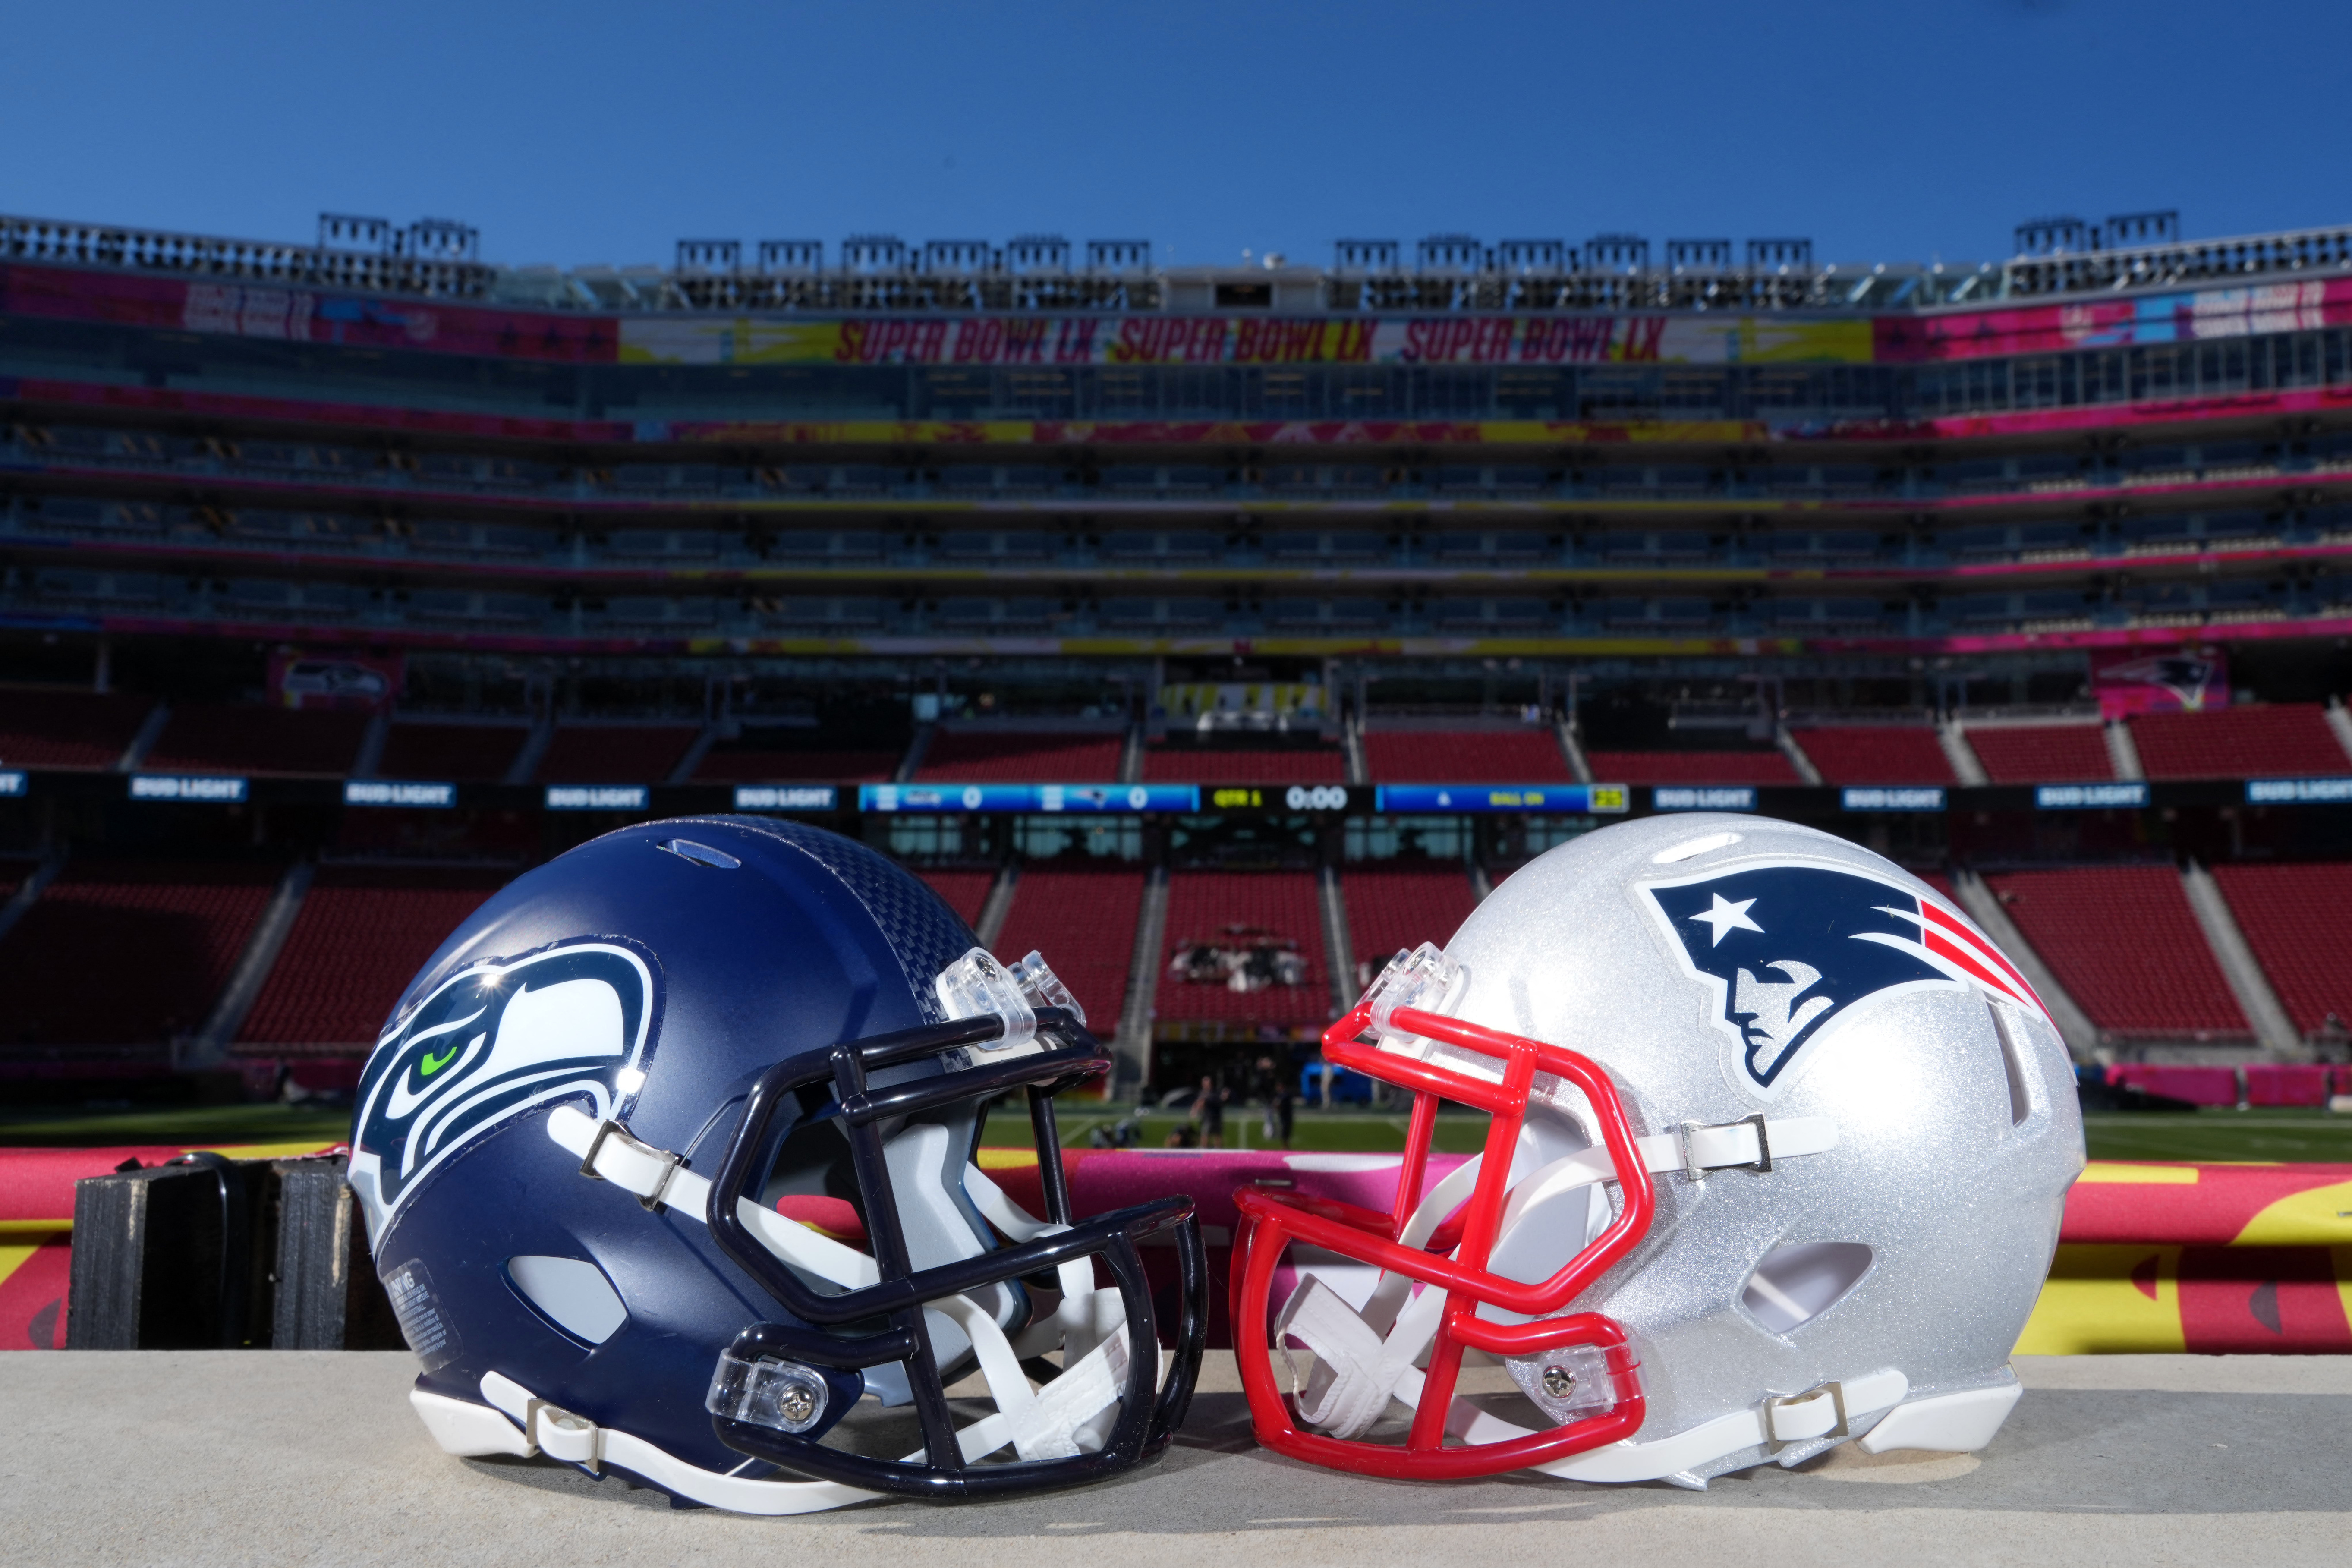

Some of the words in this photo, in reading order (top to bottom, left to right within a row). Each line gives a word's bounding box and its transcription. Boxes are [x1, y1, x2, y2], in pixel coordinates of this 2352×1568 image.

[838, 319, 946, 362] SUPER
[955, 319, 1046, 362] BOWL
[1056, 319, 1099, 362] LX
[1117, 319, 1227, 362] SUPER
[1235, 319, 1324, 362] BOWL
[1337, 319, 1379, 362] LX
[1404, 319, 1514, 362] SUPER
[1522, 319, 1612, 362] BOWL
[1624, 319, 1666, 362] LX
[132, 778, 178, 795] BUD
[180, 780, 241, 798] LIGHT
[347, 784, 390, 801] BUD
[391, 786, 450, 803] LIGHT
[548, 789, 587, 806] BUD
[589, 789, 643, 806] LIGHT
[737, 789, 776, 806] BUD
[778, 789, 831, 806] LIGHT
[963, 786, 982, 809] 0
[1128, 786, 1148, 809] 0
[2040, 788, 2083, 805] BUD
[2084, 786, 2144, 804] LIGHT
[2251, 783, 2295, 800] BUD
[1214, 789, 1249, 808] QTR
[1287, 786, 1348, 810] 0:00
[1656, 790, 1695, 807] BUD
[1697, 790, 1751, 807] LIGHT
[1845, 790, 1885, 807] BUD
[1886, 790, 1941, 807] LIGHT
[412, 1287, 420, 1296] HEAD
